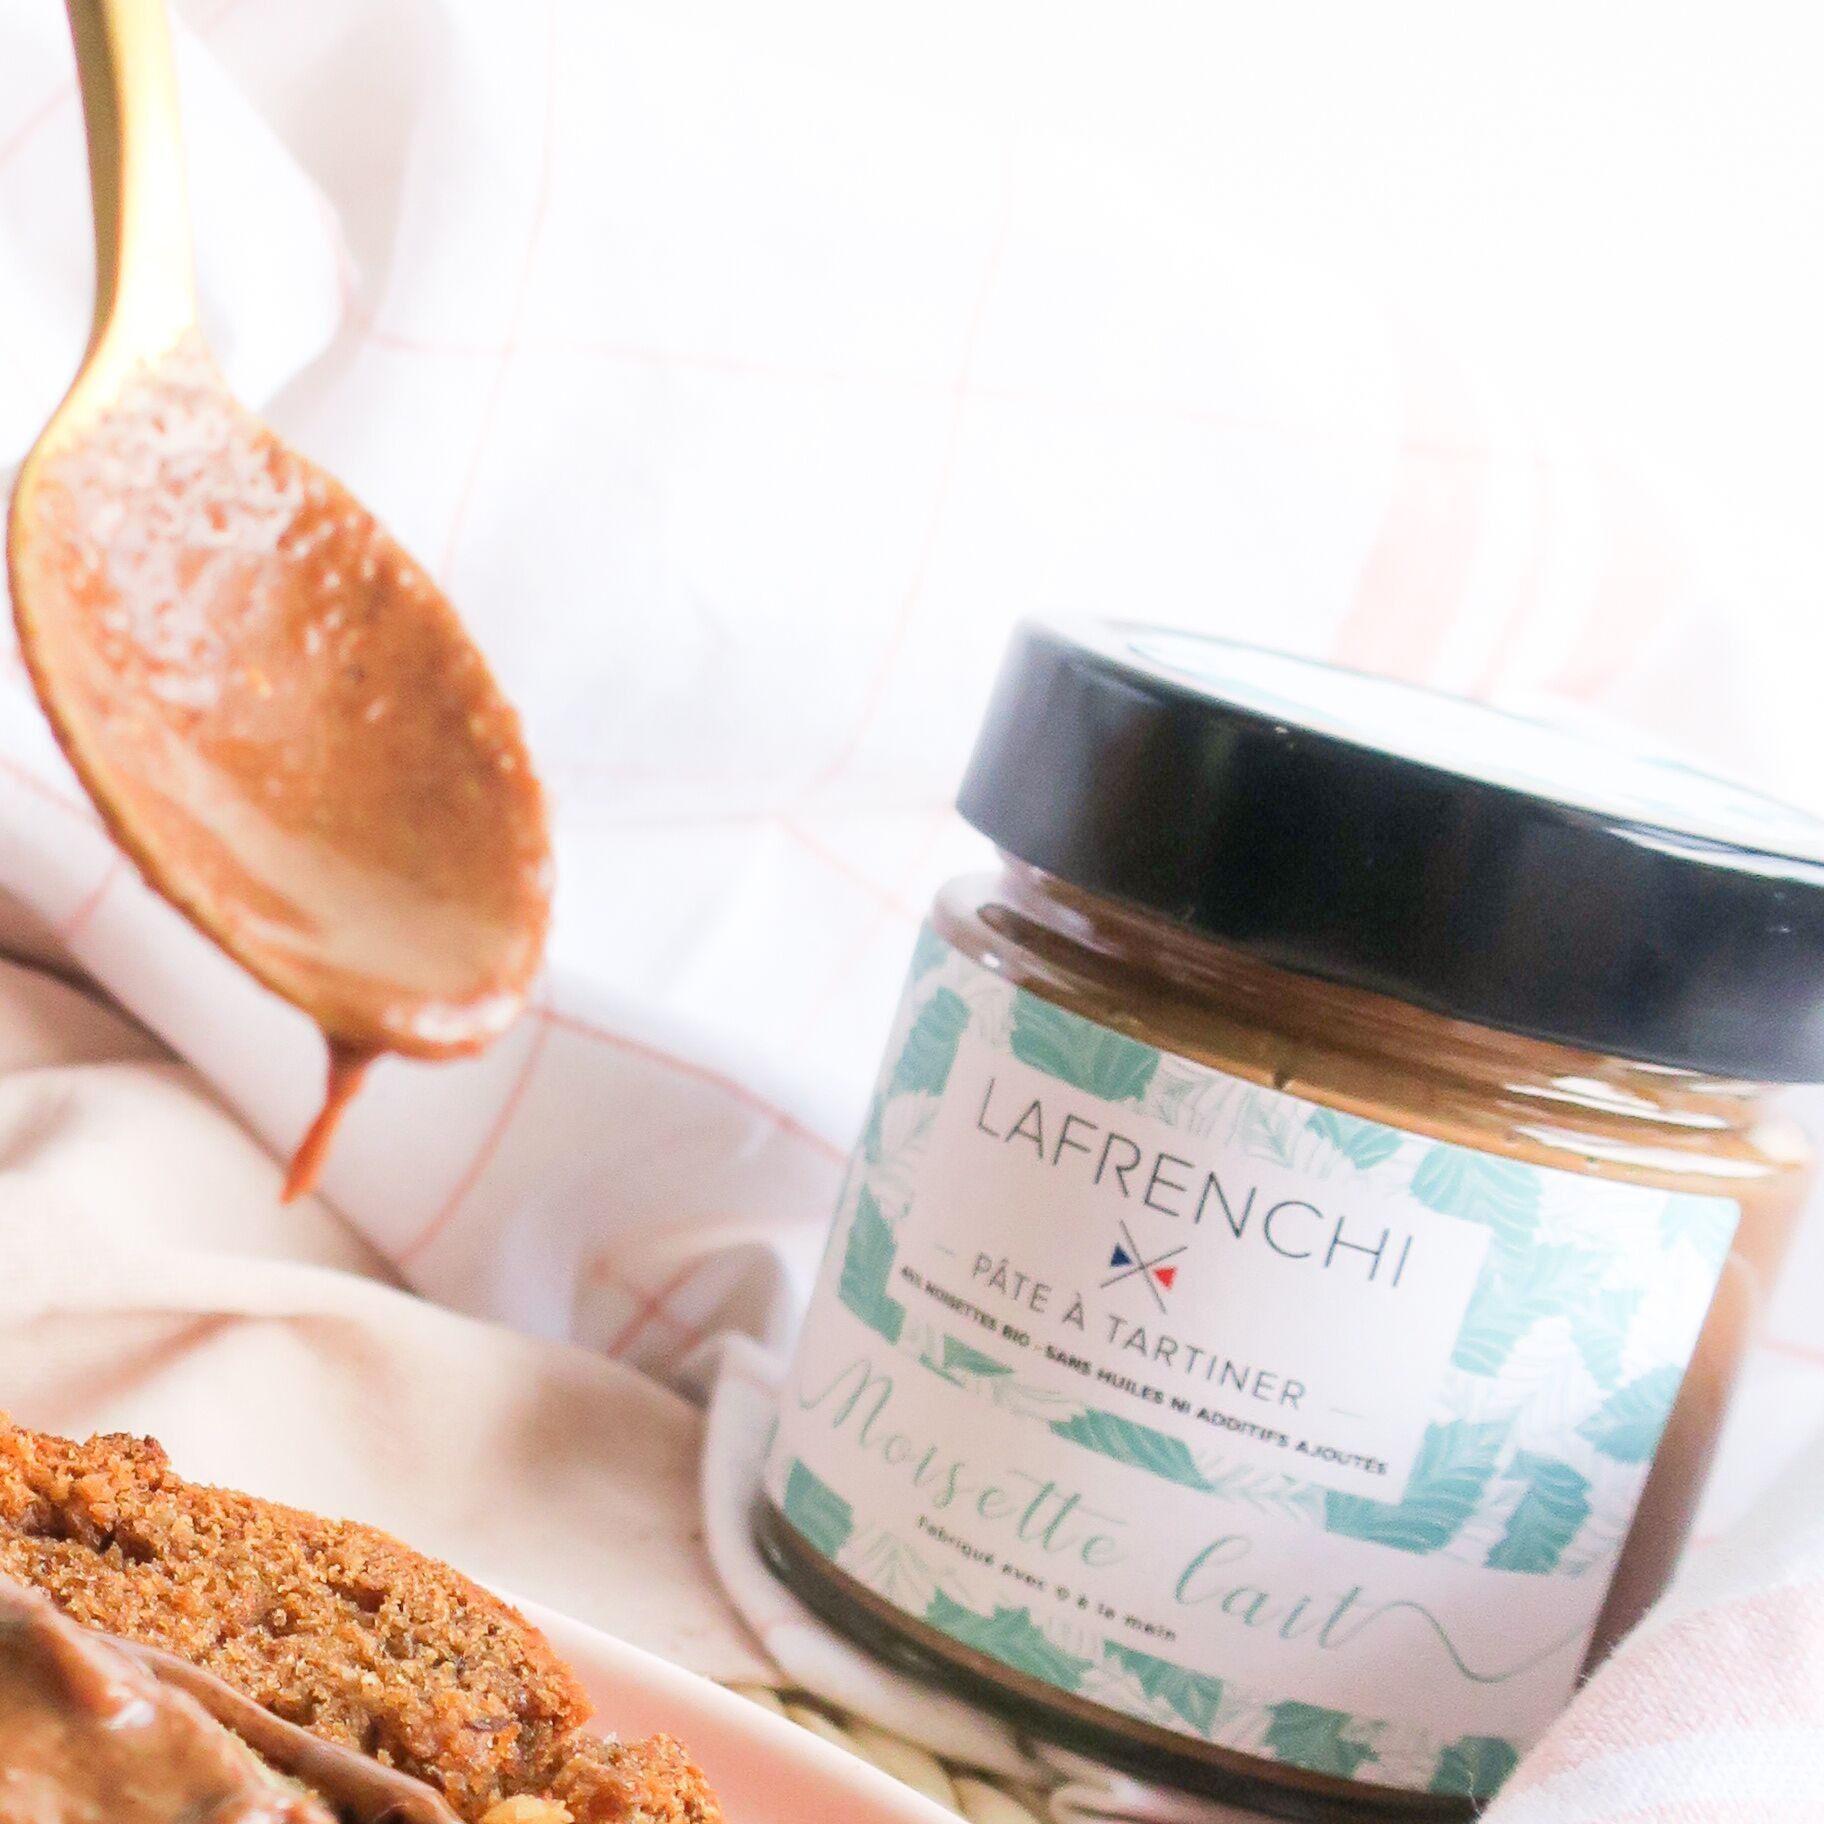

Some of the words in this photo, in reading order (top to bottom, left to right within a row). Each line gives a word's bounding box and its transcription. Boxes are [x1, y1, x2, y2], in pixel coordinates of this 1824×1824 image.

[975, 1076, 1414, 1289] LAFRENCHI
[972, 1251, 1052, 1314] PÂTE
[1062, 1291, 1085, 1331] À
[1107, 1313, 1307, 1411] TARTINER
[1002, 1325, 1031, 1348] BIO
[1045, 1344, 1092, 1376] SANS
[1096, 1367, 1165, 1406] HUILES
[1170, 1396, 1192, 1414] NI
[1196, 1406, 1290, 1448] ADDITIFS
